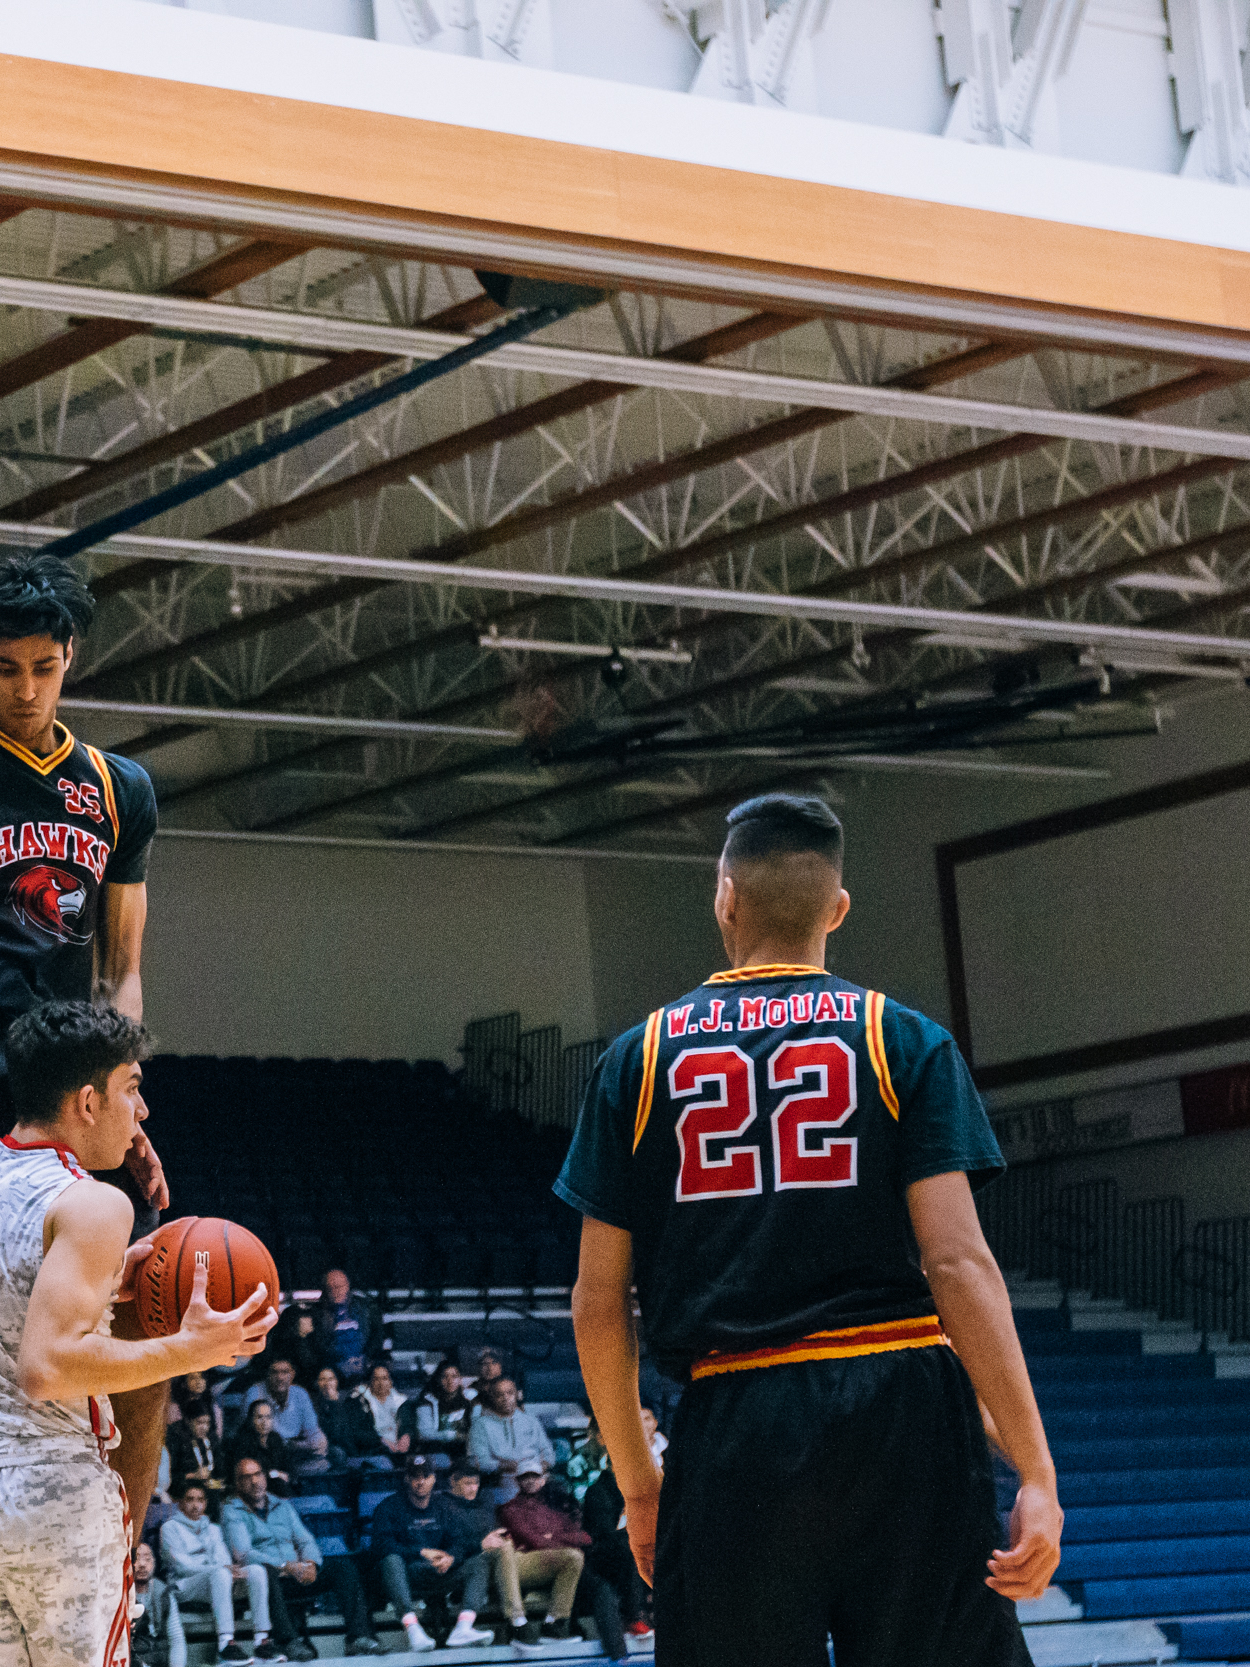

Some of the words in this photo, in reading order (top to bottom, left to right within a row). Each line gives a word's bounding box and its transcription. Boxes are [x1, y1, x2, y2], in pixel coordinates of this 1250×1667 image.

[58, 777, 104, 823] 35
[667, 1000, 733, 1038] W.J.
[737, 991, 860, 1031] MOUAT
[667, 1035, 858, 1203] 22
